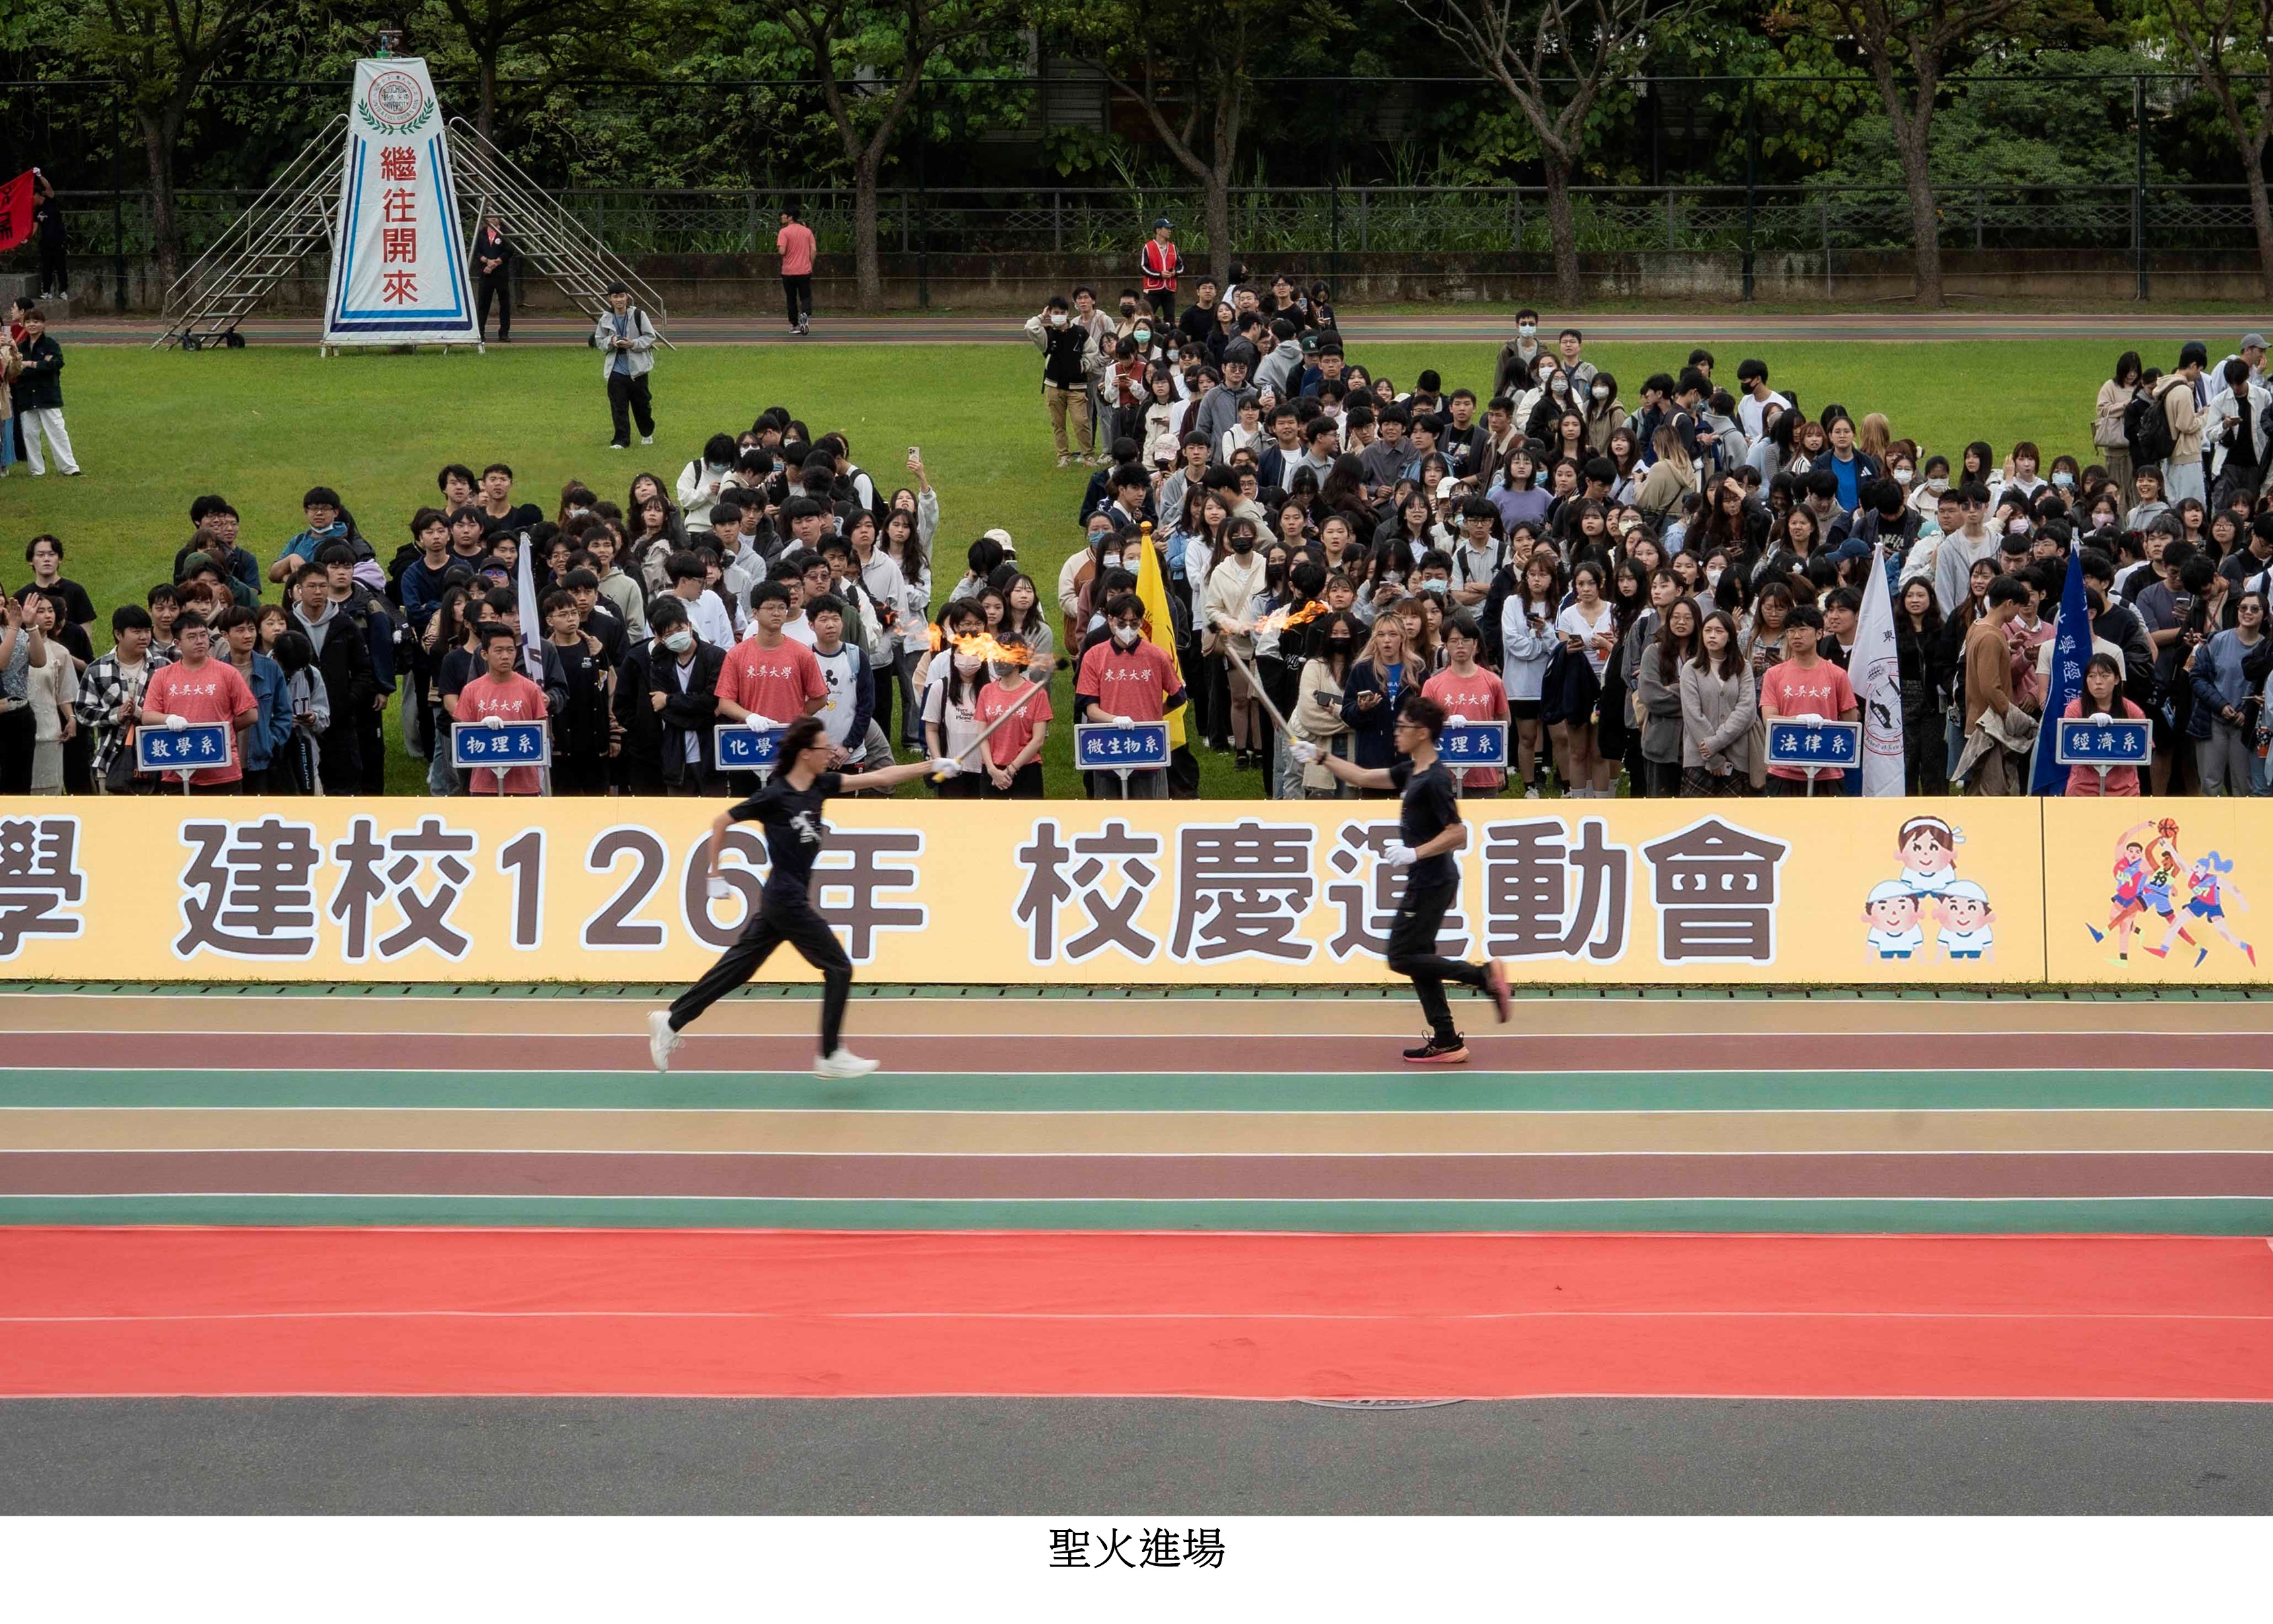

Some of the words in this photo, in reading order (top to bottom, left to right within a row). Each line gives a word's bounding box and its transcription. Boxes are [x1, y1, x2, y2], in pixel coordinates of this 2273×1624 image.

[380, 145, 418, 305] 繼往開來
[746, 665, 792, 679] 東吳大學
[1104, 668, 1152, 682] 東吳大學
[169, 683, 215, 697] 東吳大學
[1444, 693, 1490, 707] 東吳大學
[1783, 685, 1831, 699] 東吳大學
[477, 699, 523, 713] 東吳大學
[150, 735, 215, 757] 數學系
[467, 734, 533, 754] 物理系
[729, 736, 773, 757] 化學
[1087, 735, 1159, 755] 微生物系
[1779, 734, 1847, 754] 法律系
[2072, 732, 2138, 752] 經濟系
[175, 818, 924, 958] 建校126年
[1017, 819, 1787, 960] 校慶運動會
